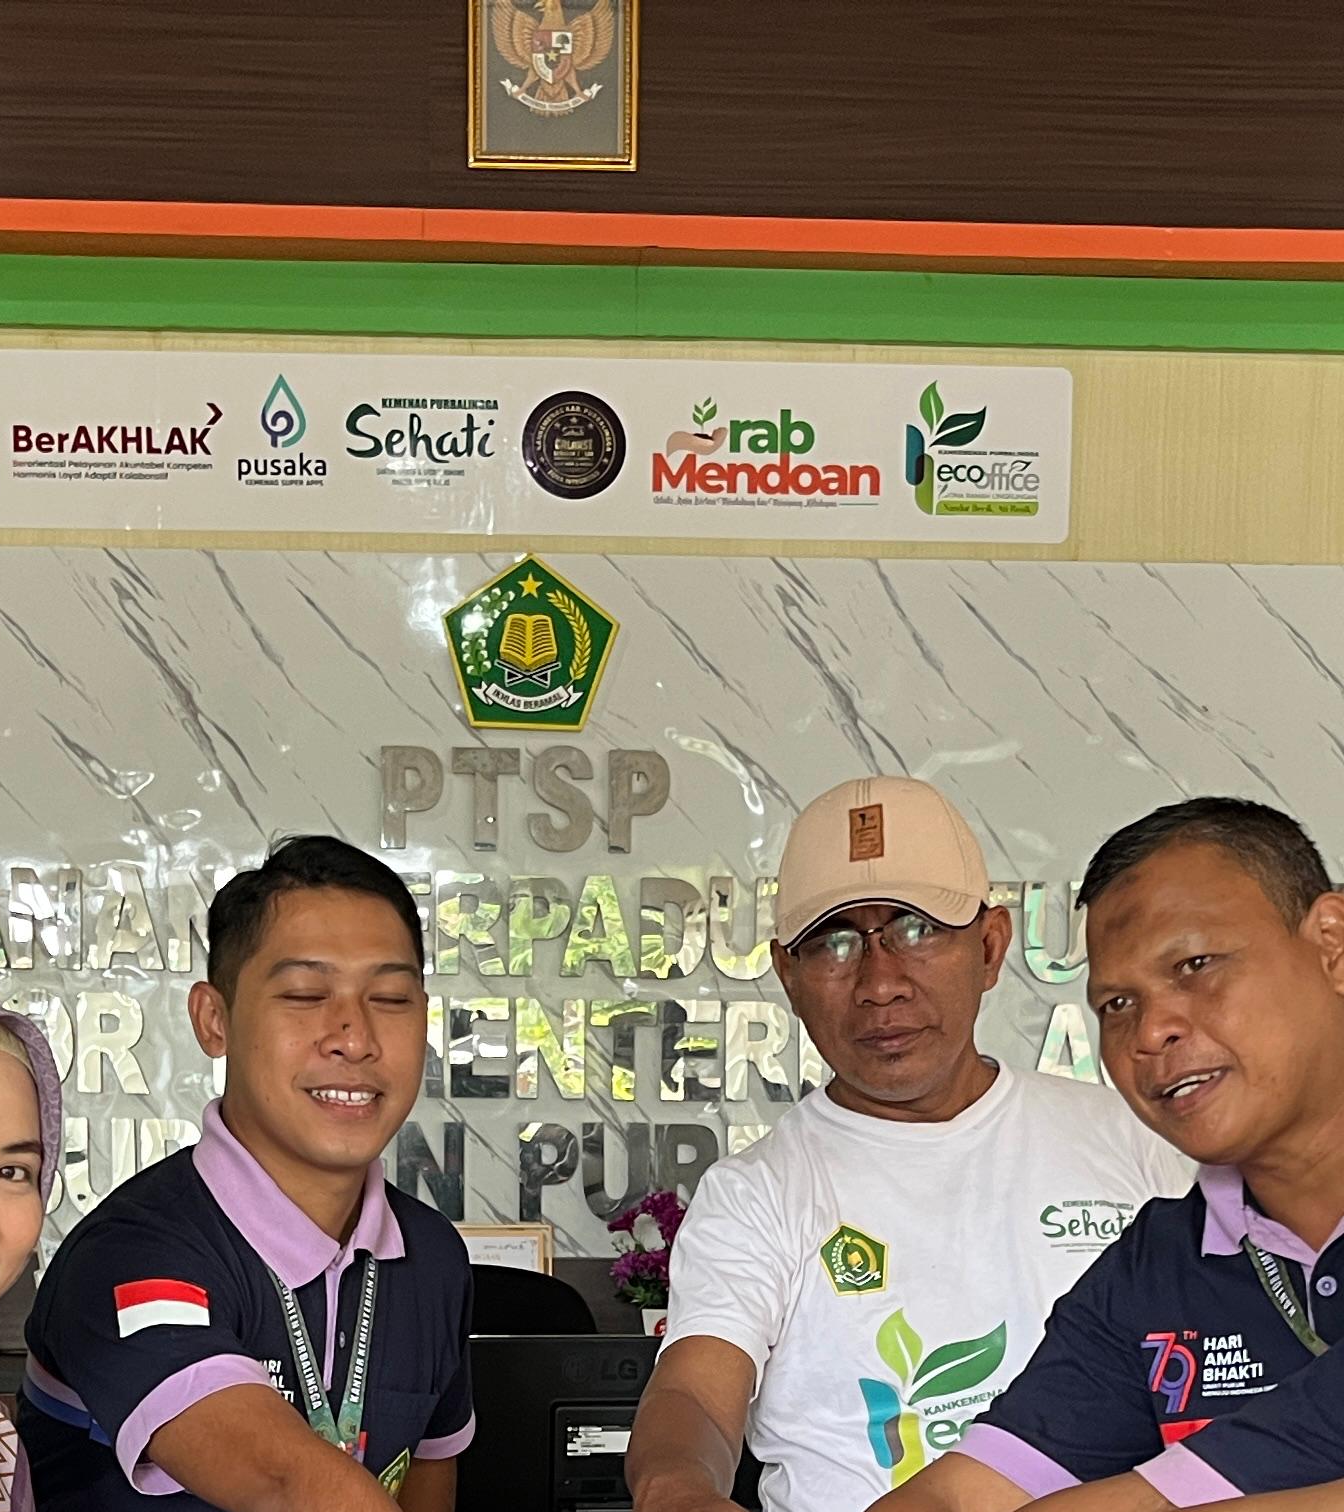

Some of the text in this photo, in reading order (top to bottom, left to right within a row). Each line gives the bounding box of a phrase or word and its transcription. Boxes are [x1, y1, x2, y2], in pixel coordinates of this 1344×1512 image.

[13, 425, 211, 455] BerAKHLAK
[346, 403, 495, 463] Sehati
[166, 462, 212, 471] Kompeten
[237, 452, 327, 480] pusaka
[652, 452, 881, 496] Mendoan
[379, 745, 671, 854] PTSP
[1269, 1276, 1297, 1318] KANTOR
[349, 1357, 364, 1403] KANTOR
[357, 1280, 374, 1357] KEMENTERIAN
[1203, 1333, 1243, 1351] HARI
[1204, 1349, 1252, 1366] AMAL
[293, 1329, 323, 1410] PURBALINGGA
[1202, 1362, 1263, 1382] BHAKTI
